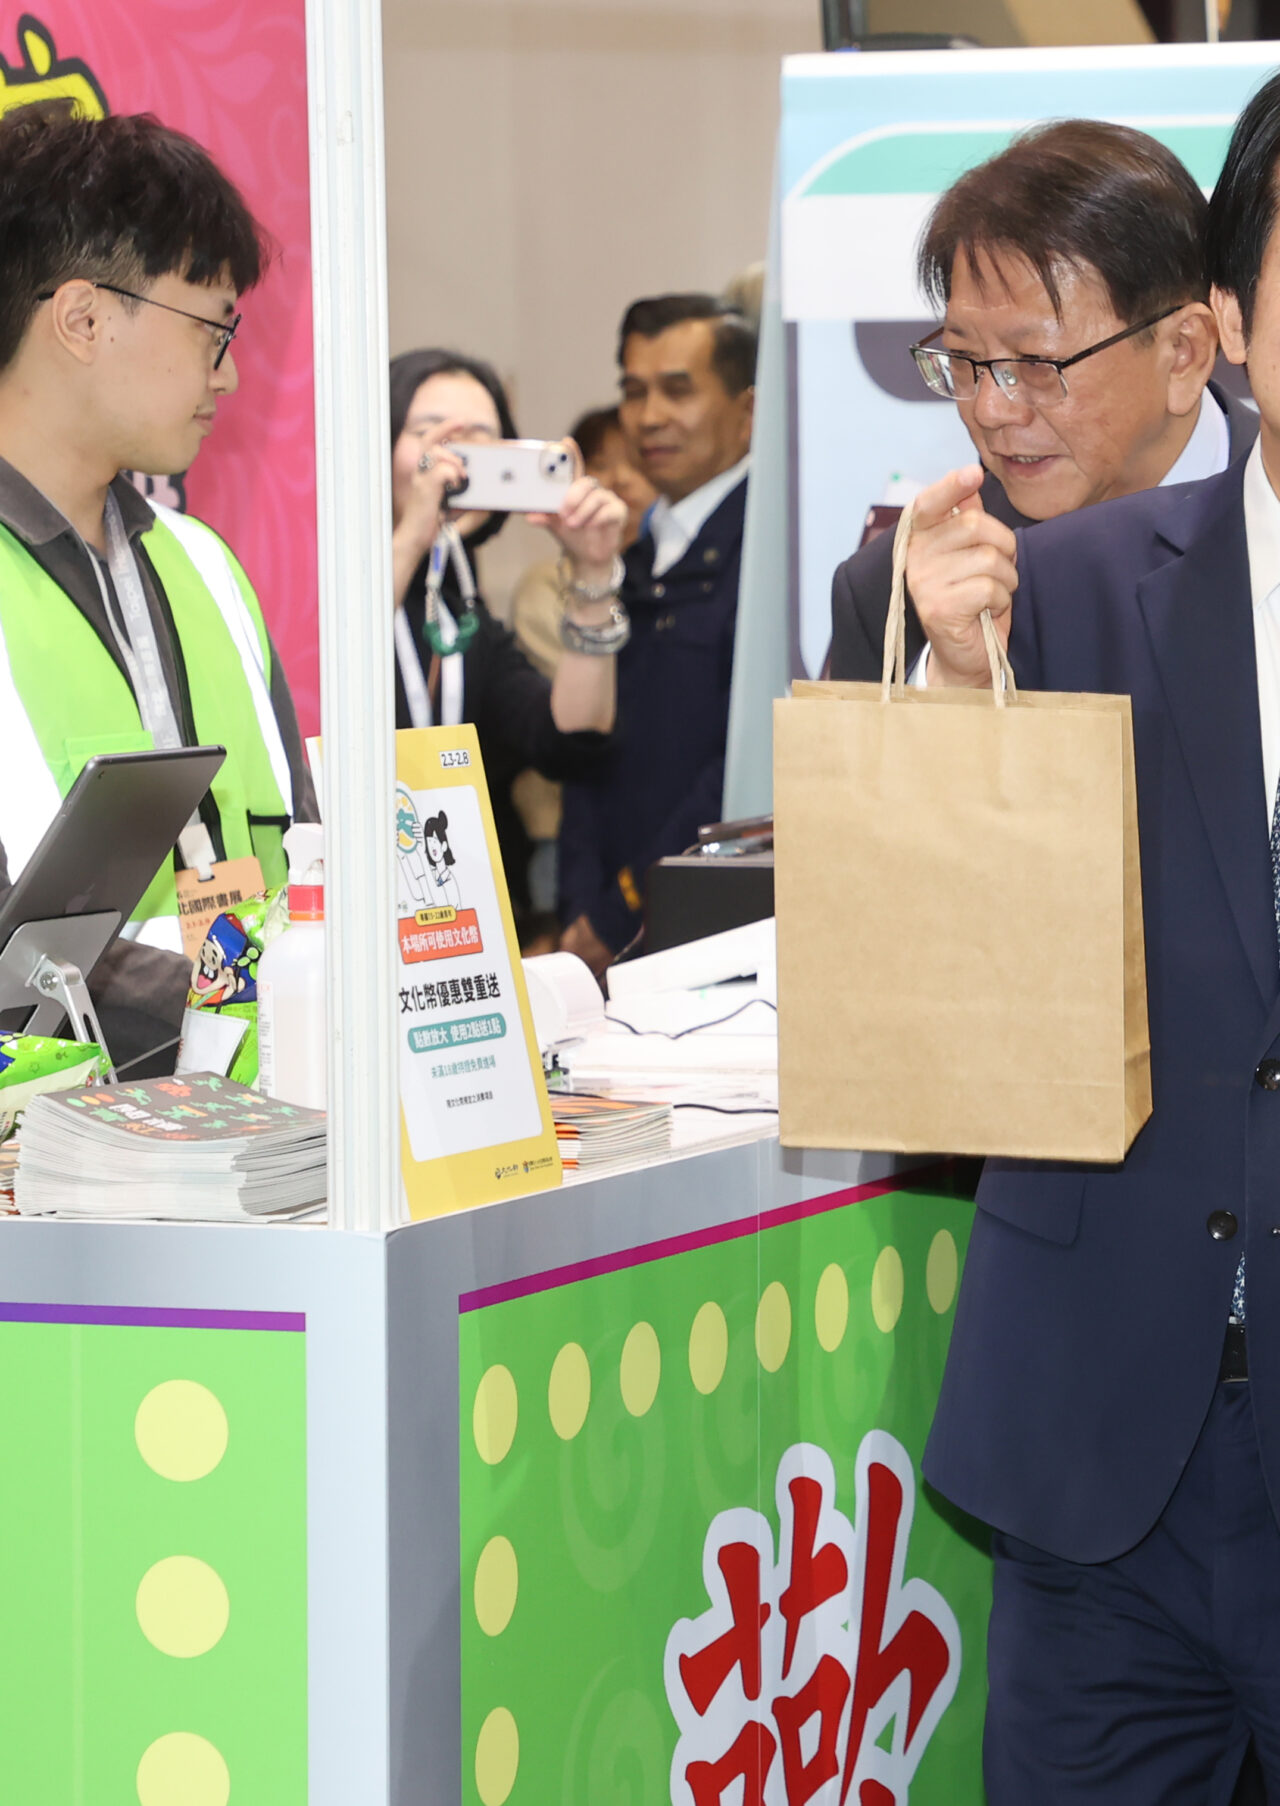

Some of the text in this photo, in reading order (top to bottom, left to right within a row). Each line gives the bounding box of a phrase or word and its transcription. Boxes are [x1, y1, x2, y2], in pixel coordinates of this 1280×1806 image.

[441, 751, 470, 768] 2.3-2.8
[401, 925, 479, 954] 本場所可使用文化幣
[399, 973, 501, 1014] 文化幣優惠雙重送
[413, 1017, 501, 1050] 點數放大 使用2點送1點
